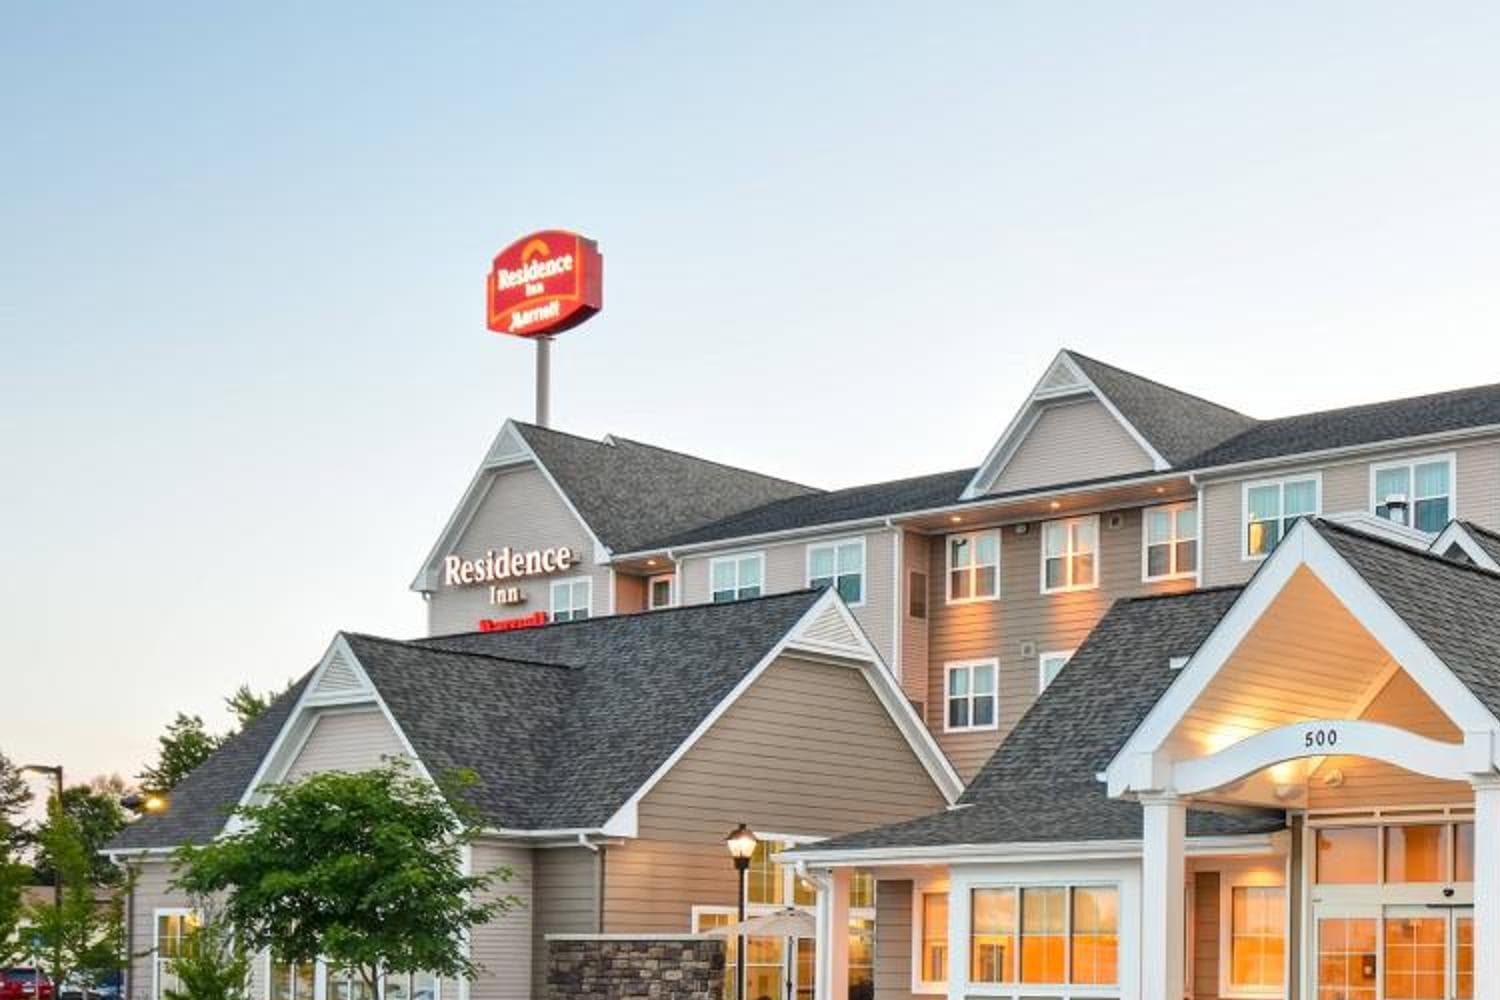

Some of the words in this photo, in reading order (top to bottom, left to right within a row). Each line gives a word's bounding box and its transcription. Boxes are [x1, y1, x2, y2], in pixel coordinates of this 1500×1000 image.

[498, 254, 573, 290] Residence
[525, 283, 544, 297] Inn
[445, 546, 571, 585] Residence
[489, 585, 520, 604] Inn
[1305, 729, 1337, 747] 500
